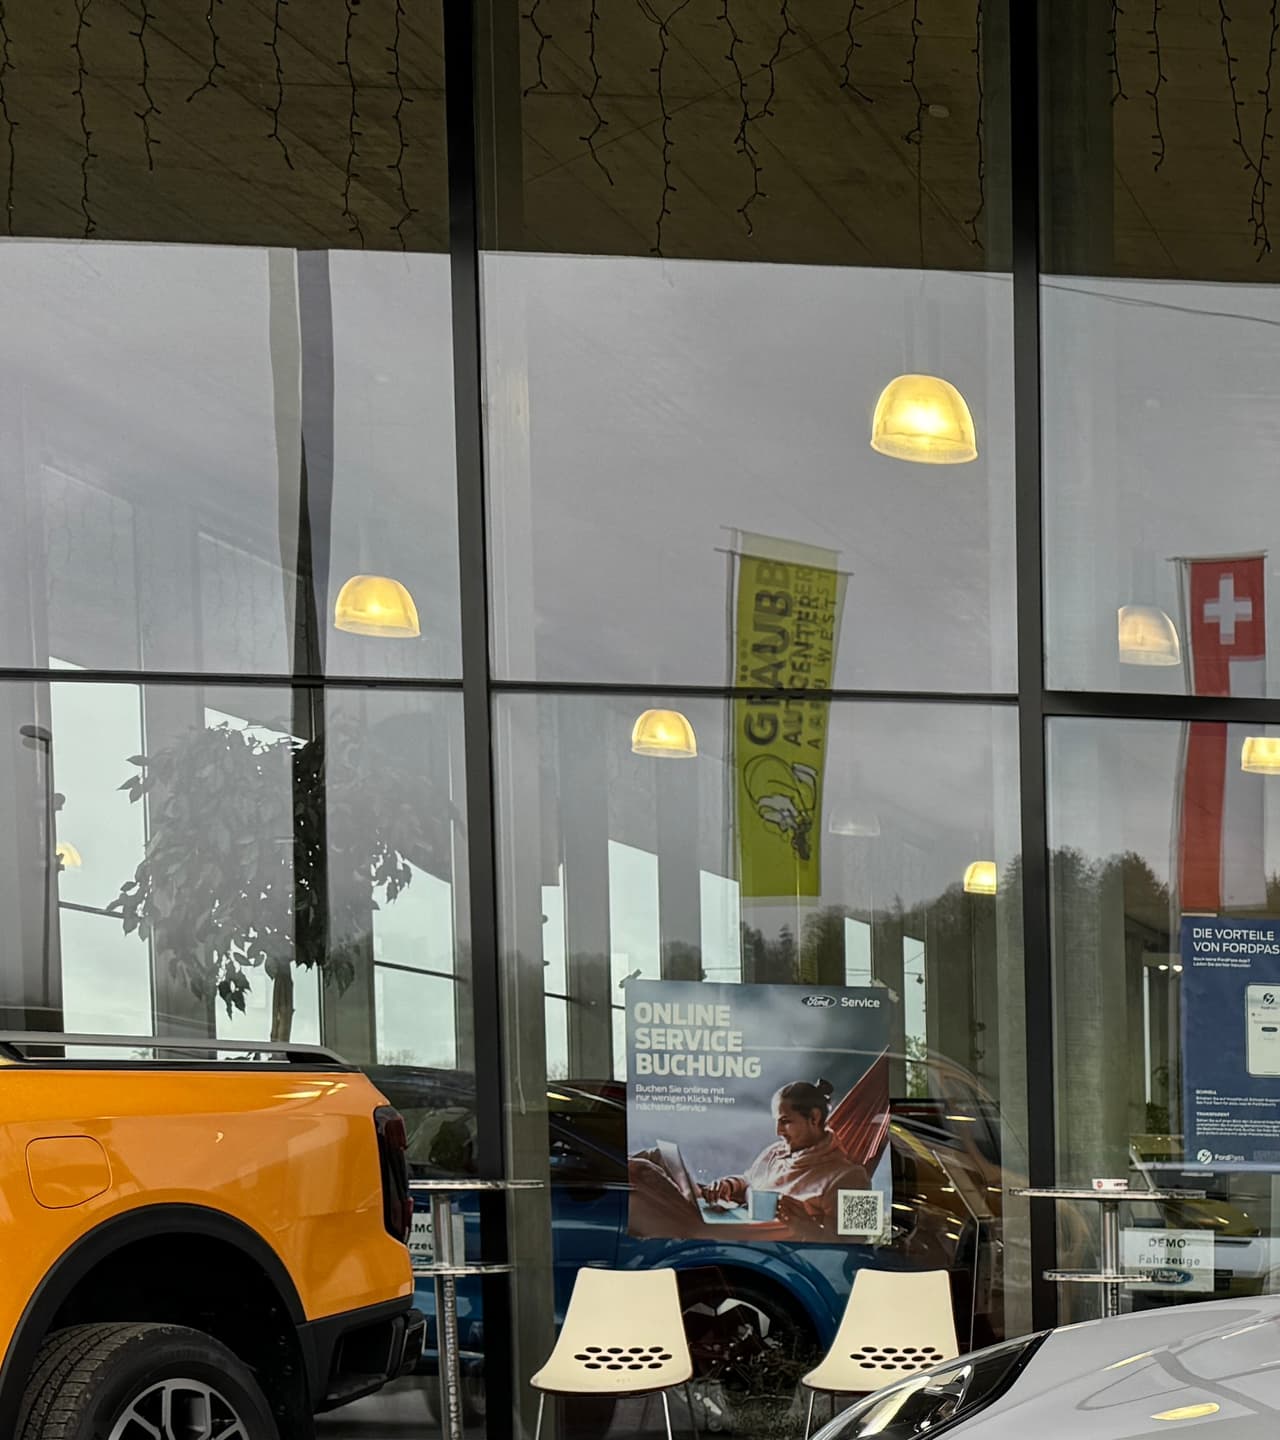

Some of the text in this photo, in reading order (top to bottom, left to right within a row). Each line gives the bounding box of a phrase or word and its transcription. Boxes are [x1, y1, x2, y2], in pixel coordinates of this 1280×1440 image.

[781, 594, 820, 747] AUTCENTER
[1192, 927, 1275, 942] DIE VORTEILE
[1192, 941, 1220, 953] VON
[840, 996, 881, 1009] Service
[633, 1001, 731, 1027] ONLINE
[634, 1027, 743, 1053] SERVICE
[635, 1054, 762, 1079] BUCHUNG
[635, 1083, 725, 1095] Buchen Sie online mit
[635, 1094, 736, 1106] nur wenigen Klicks Ihren
[675, 1103, 708, 1113] Service
[1148, 1238, 1191, 1249] DEMO-
[1138, 1254, 1201, 1268] Fahrzeuge
